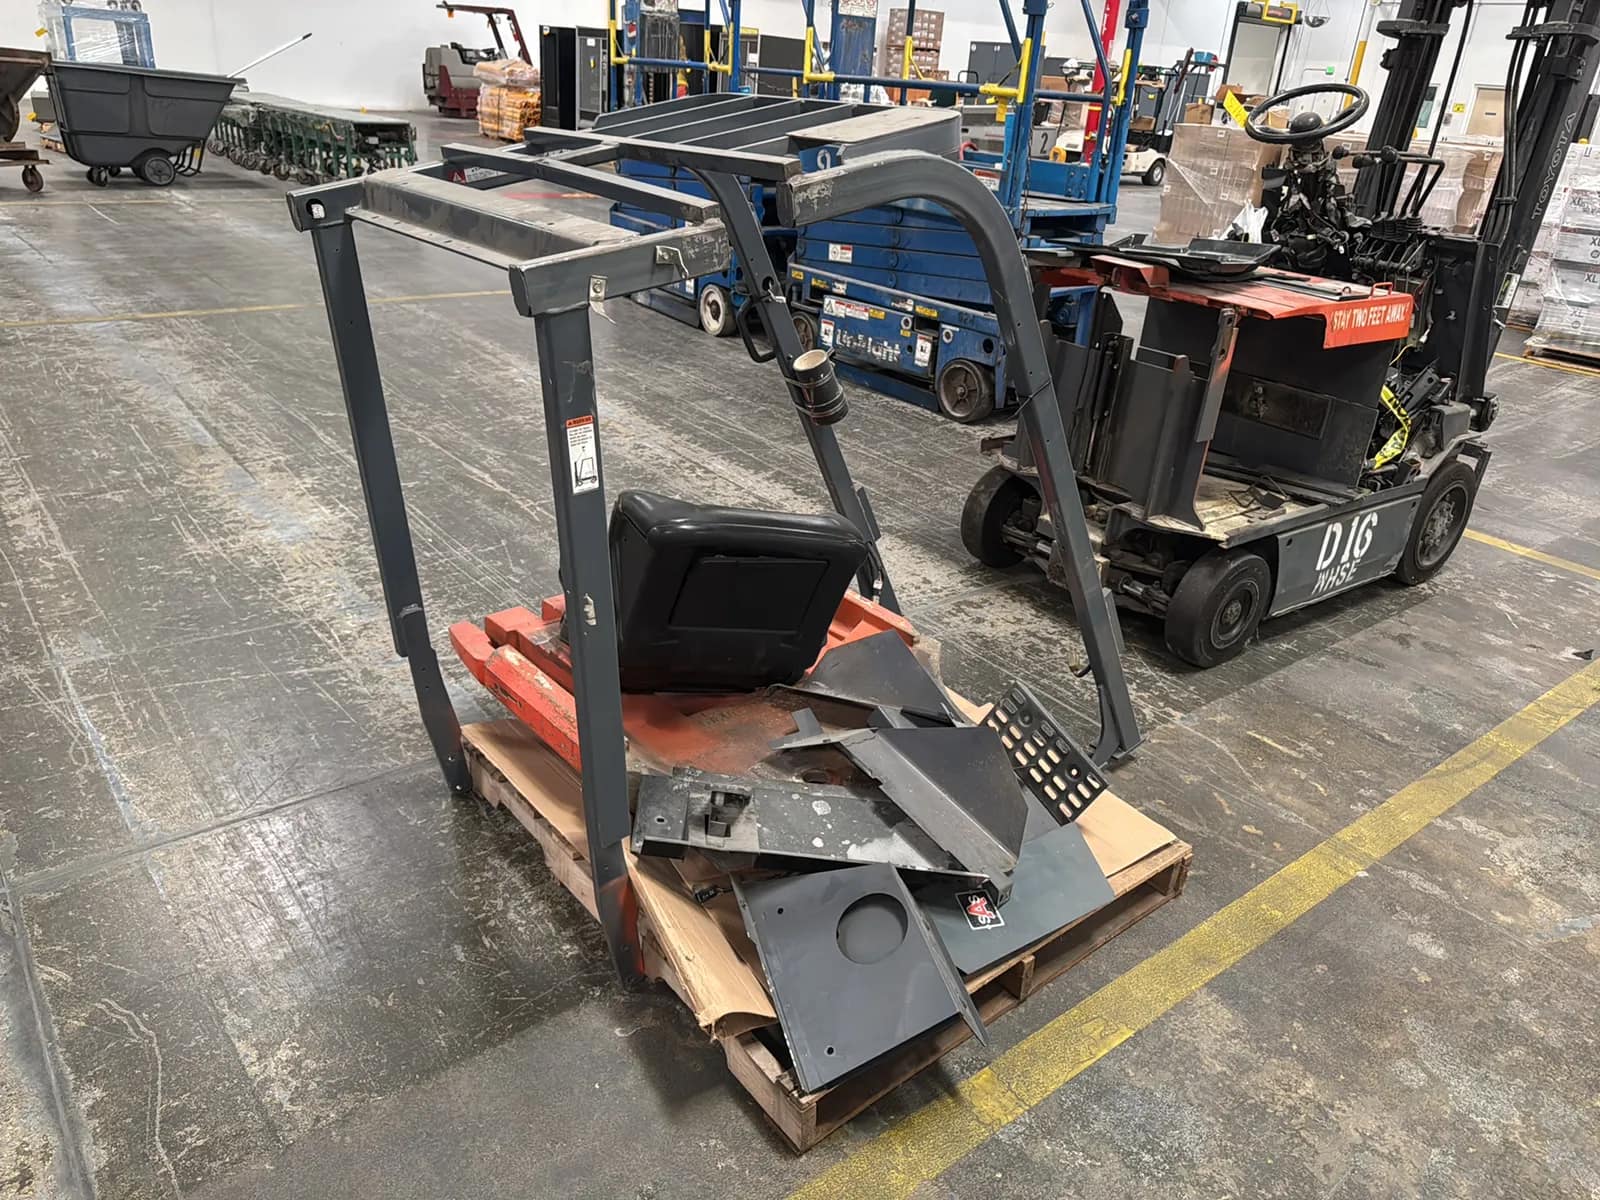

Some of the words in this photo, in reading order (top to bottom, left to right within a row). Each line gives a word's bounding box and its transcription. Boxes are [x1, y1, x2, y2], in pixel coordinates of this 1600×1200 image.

[1040, 132, 1049, 154] 2
[1531, 112, 1577, 219] TOYOTA
[1584, 273, 1598, 283] XL
[1352, 308, 1368, 328] TWO
[1367, 305, 1387, 327] FEET
[1311, 559, 1361, 596] WHSE
